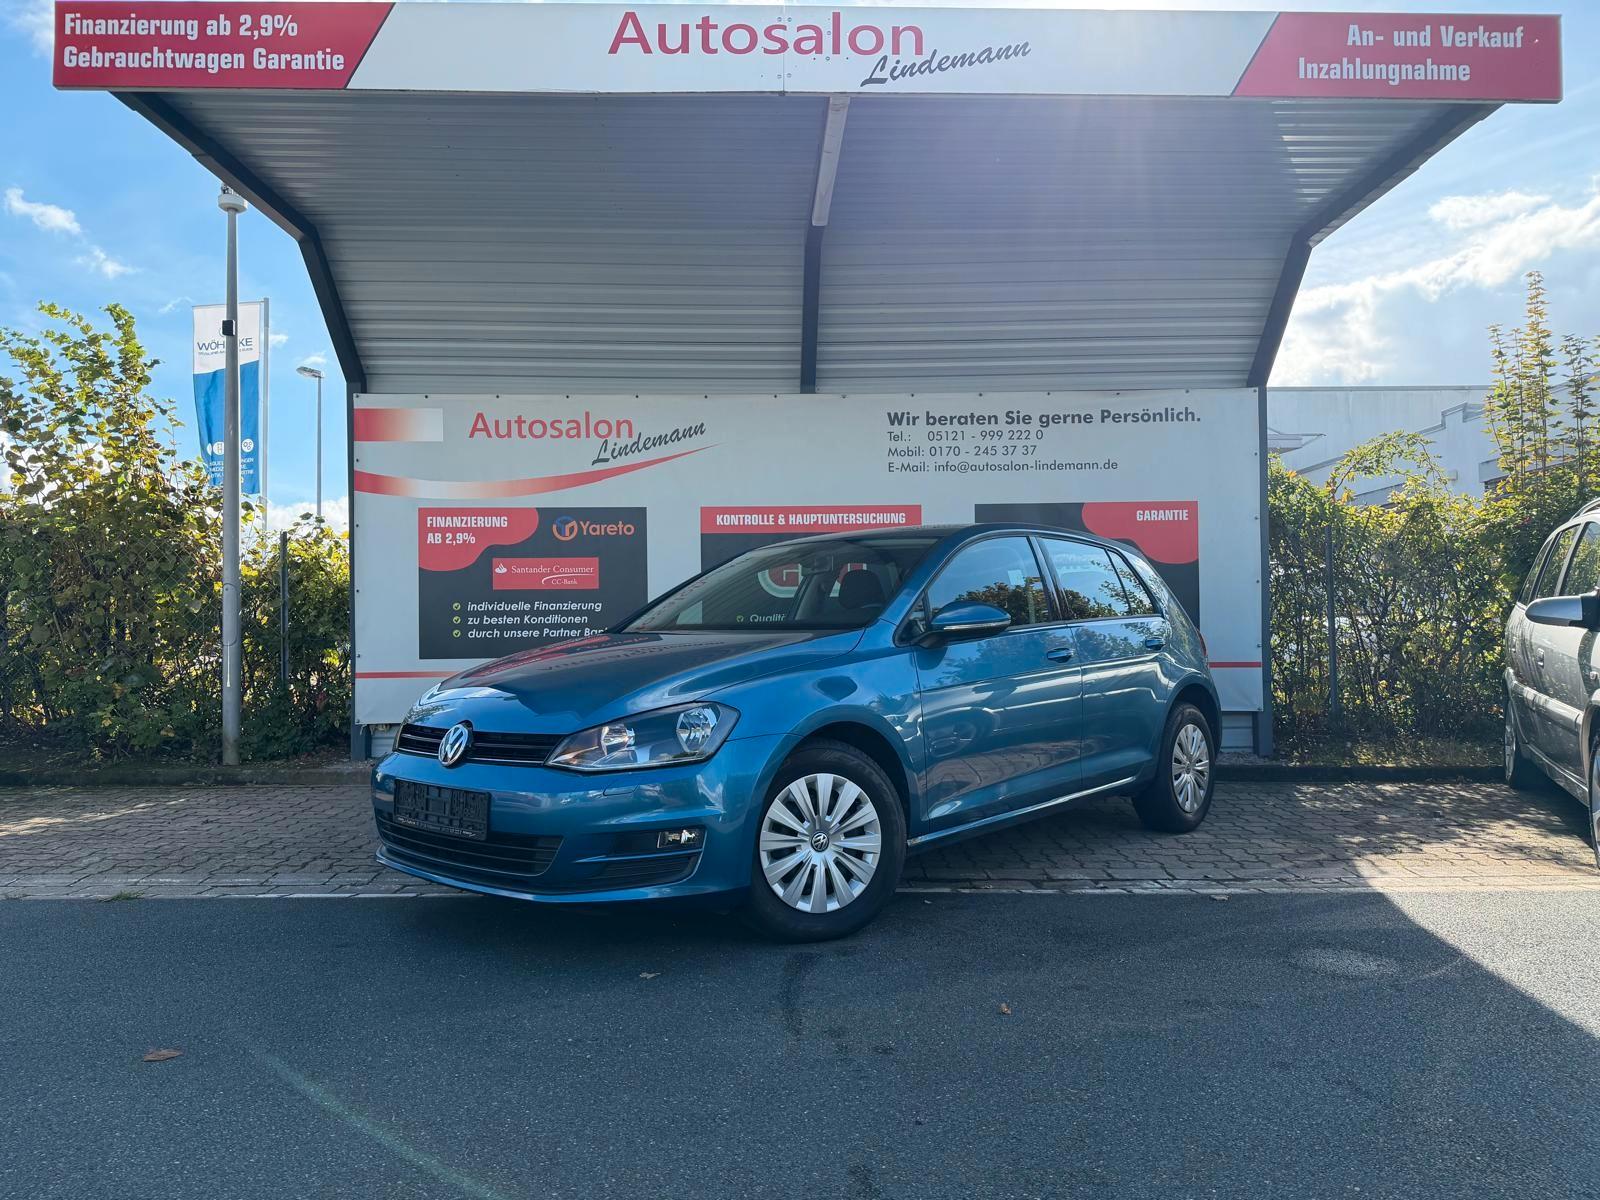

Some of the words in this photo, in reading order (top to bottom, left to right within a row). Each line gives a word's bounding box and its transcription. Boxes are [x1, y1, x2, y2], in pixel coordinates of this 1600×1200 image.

[64, 13, 198, 40] Finanzierung
[206, 14, 231, 35] ab
[239, 14, 298, 40] 2,9%
[608, 11, 924, 57] Autosalon
[1347, 25, 1384, 47] An-
[1393, 26, 1431, 48] und
[1440, 26, 1524, 48] Verkauf
[63, 46, 245, 74] Gebrauchtwagen
[253, 47, 345, 70] Garantie
[860, 39, 1031, 87] Lindemann
[1299, 57, 1471, 86] Inzahlungnahme
[468, 411, 634, 439] Autosalon
[887, 411, 920, 427] Wir
[925, 411, 999, 426] beraten
[1004, 409, 1033, 425] Sie
[1038, 412, 1094, 428] gerne
[1100, 407, 1202, 424] Persönlich.
[887, 431, 912, 442] Tel.:
[927, 430, 966, 442] 05121
[980, 430, 1004, 441] 999
[1008, 429, 1031, 441] 222
[1035, 429, 1044, 441] 0
[591, 421, 706, 466] Lindemann
[887, 446, 925, 457] Mobil:
[929, 445, 961, 457] 0170
[973, 445, 998, 456] 245
[1001, 445, 1018, 456] 37
[1021, 445, 1037, 456] 37
[887, 461, 930, 472] E-Mail:
[934, 459, 1118, 474] info@autosalon-lindemann.de
[426, 516, 508, 528] FINANZIERUNG
[716, 514, 775, 526] KONTROLLE
[778, 513, 786, 525] &
[788, 512, 906, 525] HAUPTUNTERSUCHUNG
[1136, 509, 1189, 521] GARANTIE
[579, 521, 635, 536] Yareto
[426, 533, 442, 544] AB
[445, 532, 476, 546] 2,9%
[511, 564, 551, 574] Santander
[552, 564, 594, 574] Consumer
[467, 601, 531, 612] individuelle
[534, 601, 603, 614] Finanzierung
[467, 616, 480, 625] zu
[483, 615, 520, 625] besten
[523, 614, 588, 625] Konditionen
[467, 629, 500, 639] durch
[503, 629, 540, 638] unsere
[543, 627, 581, 637] Partner
[584, 627, 608, 637] Ban
